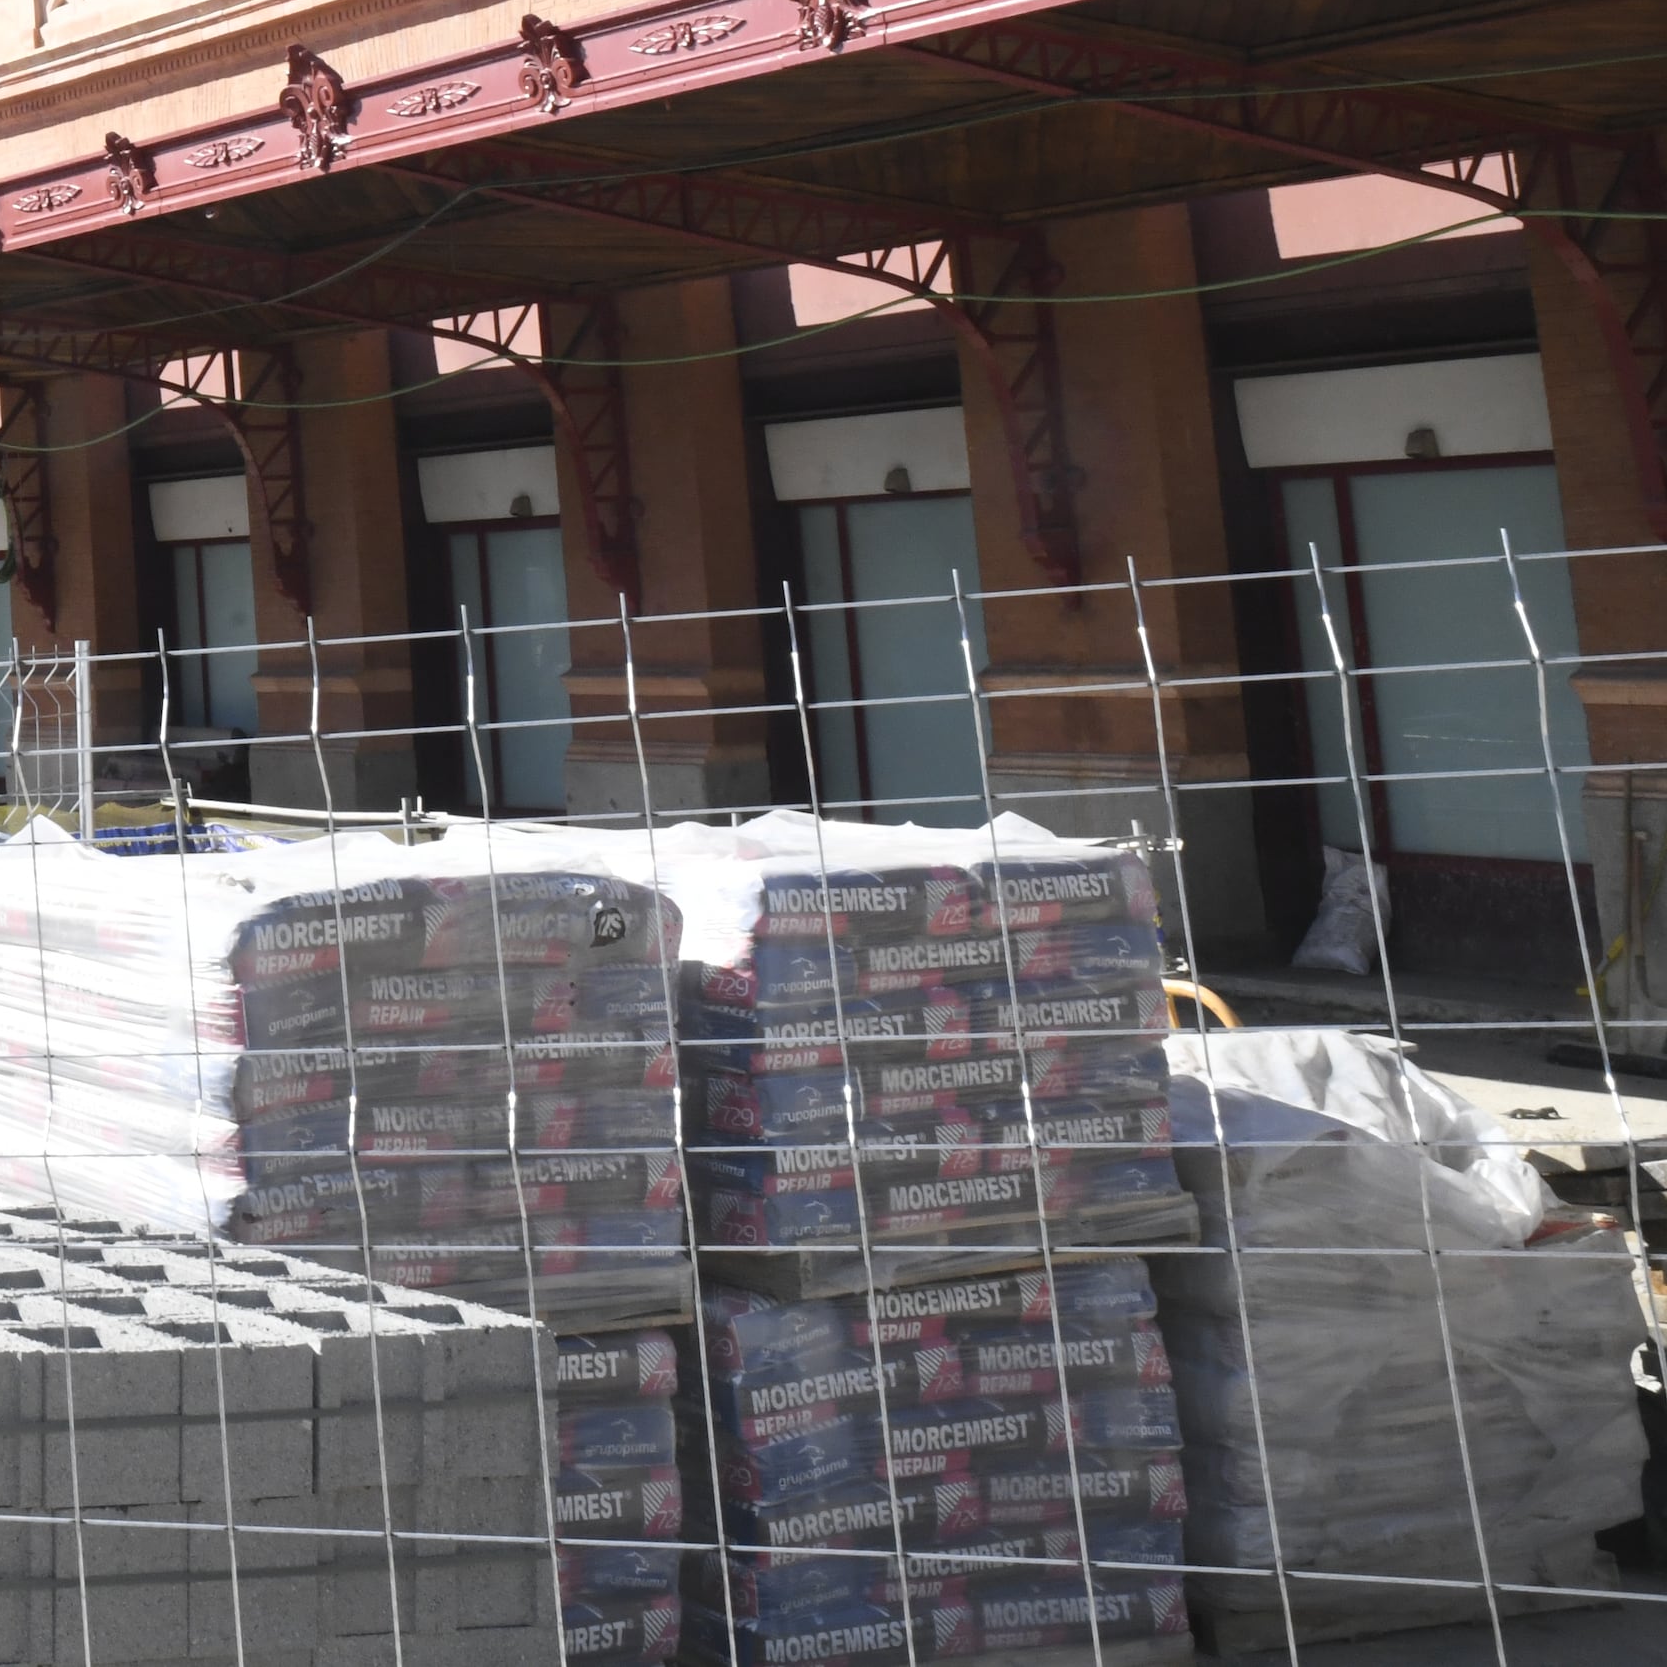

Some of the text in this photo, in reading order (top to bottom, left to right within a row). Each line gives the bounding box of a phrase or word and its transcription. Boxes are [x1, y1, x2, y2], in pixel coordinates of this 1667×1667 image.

[768, 887, 908, 914] MORCEMREST
[989, 872, 1111, 903] MORCEMREST
[254, 913, 406, 951] MORCEMREST
[769, 916, 823, 934] REPAIR
[255, 952, 316, 976] REPAIR
[870, 939, 1000, 972] MORCEMREST
[715, 976, 749, 997] 729
[769, 978, 834, 996] grupopuma
[869, 974, 921, 991] REPAIR
[268, 1005, 337, 1035] grupopuma
[369, 1005, 426, 1026] REPAIR
[998, 996, 1121, 1028] MORCEMREST
[764, 1015, 906, 1049] MORCEMREST
[881, 1057, 1015, 1093] MORCEMREST
[719, 1104, 755, 1127] 729
[772, 1102, 844, 1124] grupopuma
[880, 1095, 934, 1115] REPAIR
[776, 1133, 919, 1174] MORCEMREST
[776, 1173, 832, 1194] REPAIR
[890, 1174, 1022, 1212] MORCEMREST
[727, 1223, 757, 1245] 729
[868, 1281, 1003, 1320] MORCEMREST
[978, 1339, 1115, 1372] MORCEMREST
[751, 1361, 897, 1415] MORCEMREST
[978, 1374, 1033, 1393] REPAIR
[754, 1410, 813, 1438] REPAIR
[892, 1413, 1029, 1454] MORCEMREST
[585, 1441, 660, 1458] grupopuma
[778, 1457, 849, 1490] grupopuma
[891, 1454, 947, 1477] REPAIR
[990, 1470, 1132, 1502] MORCEMREST
[556, 1490, 624, 1523] MREST
[769, 1496, 917, 1547] MORCEMREST
[983, 1593, 1133, 1630] MORCEMREST
